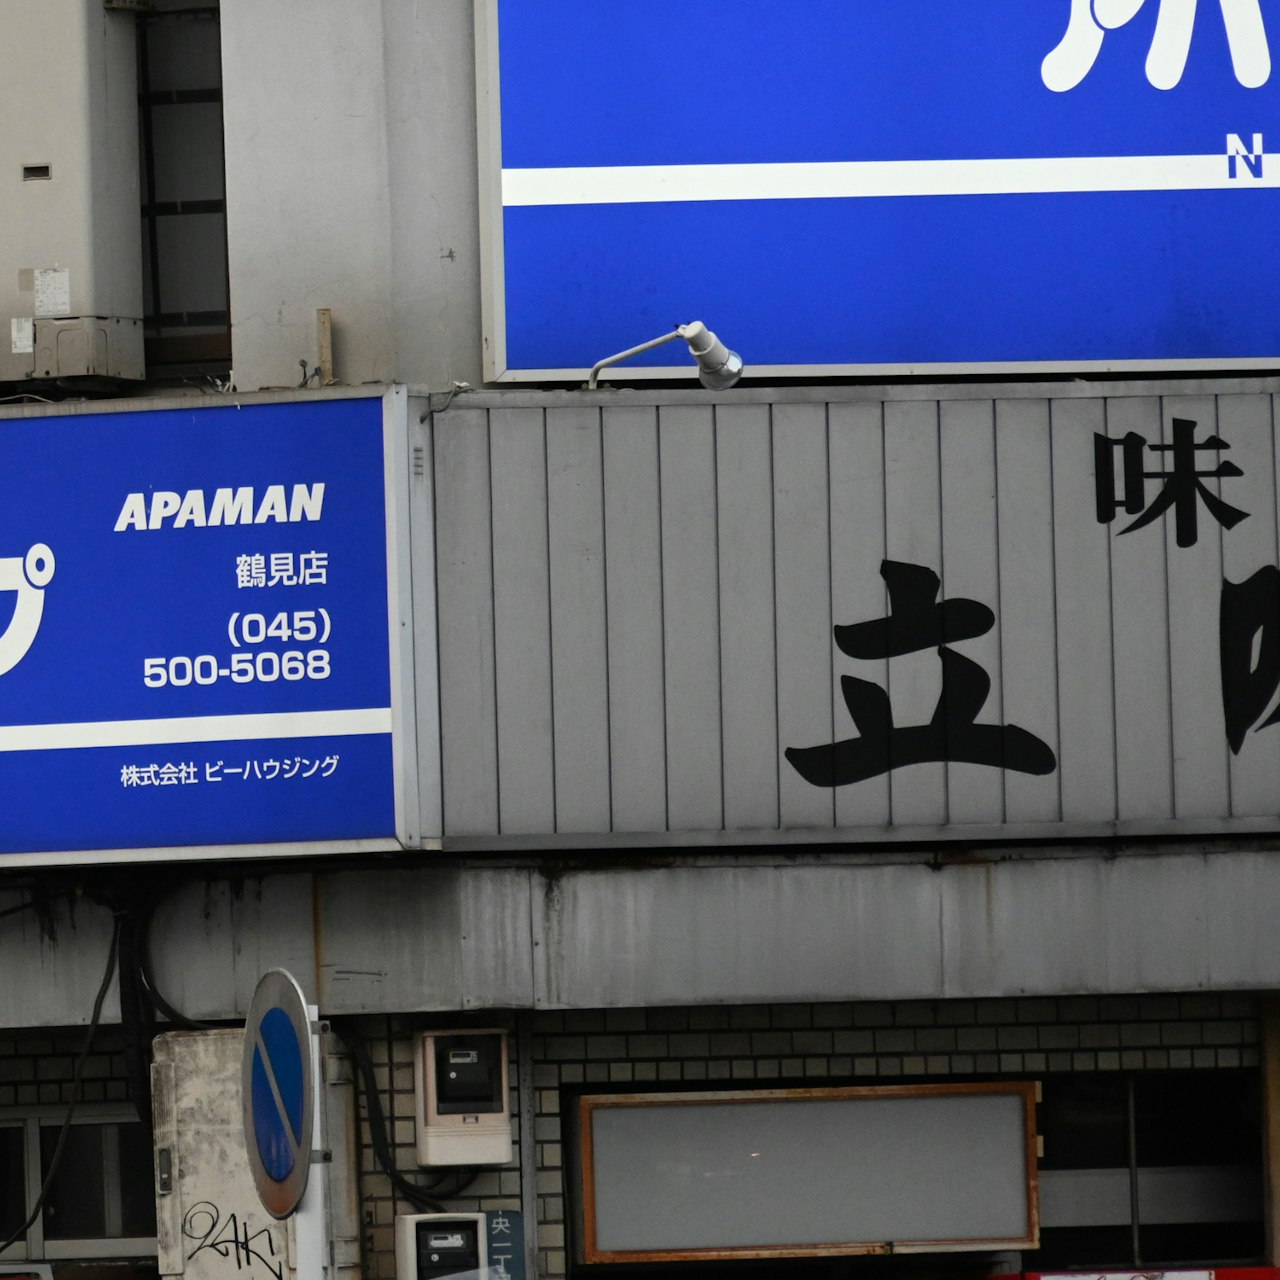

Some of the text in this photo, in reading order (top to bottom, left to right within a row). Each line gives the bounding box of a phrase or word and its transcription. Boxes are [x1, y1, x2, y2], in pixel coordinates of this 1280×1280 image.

[1094, 418, 1251, 548] 味
[113, 482, 326, 532] APAMAN
[235, 551, 329, 589] 鶴見店
[227, 608, 331, 648] (045)
[143, 649, 331, 688] 500-5068
[120, 754, 338, 787] 株式会社 ビーハウジング
